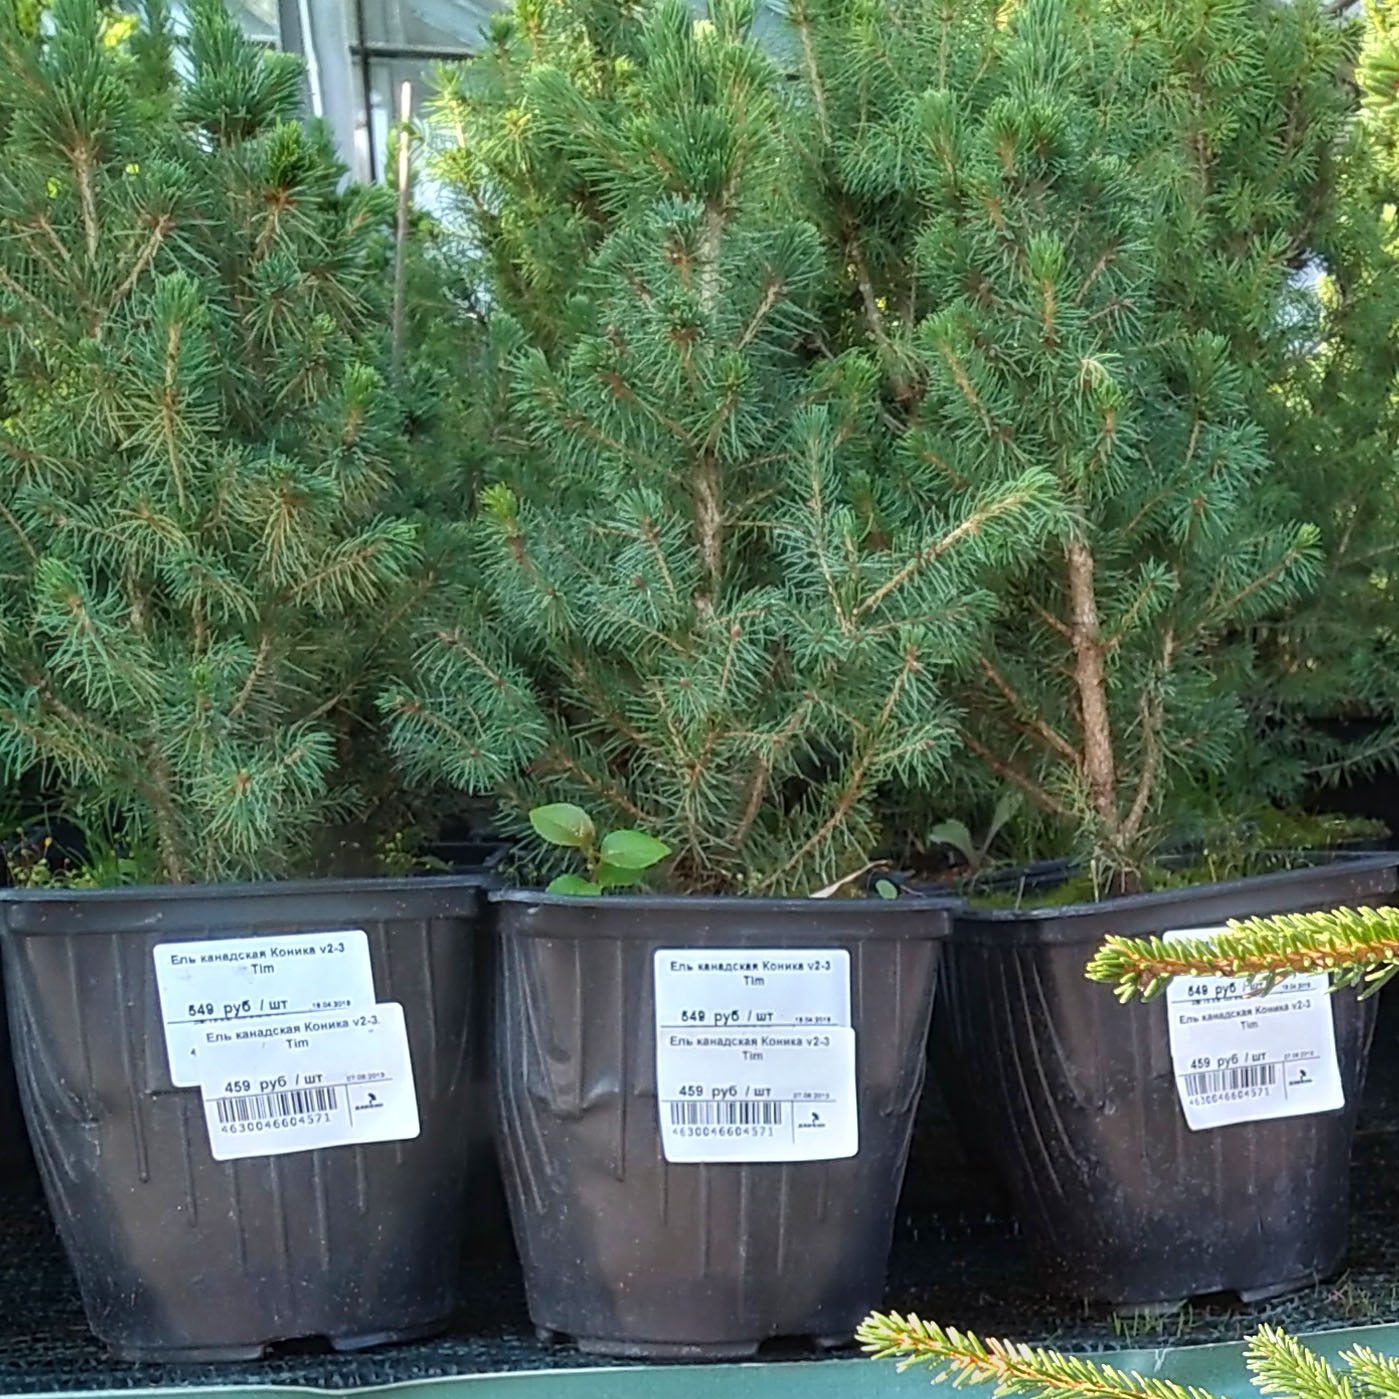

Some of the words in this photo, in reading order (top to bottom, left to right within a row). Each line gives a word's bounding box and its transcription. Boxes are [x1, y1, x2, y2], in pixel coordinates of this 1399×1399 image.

[171, 954, 196, 965] Ель
[201, 951, 267, 963] канадская
[270, 946, 316, 958] Коника
[319, 942, 346, 954] v2-3
[251, 963, 275, 974] Tim
[670, 961, 693, 972] Ель
[697, 961, 759, 972] канадская
[762, 960, 804, 971] Коника
[807, 960, 831, 971] v2-3
[743, 975, 765, 986] Tim
[1215, 982, 1236, 998] руб
[223, 1000, 251, 1018] руб
[269, 1000, 288, 1011] шт
[1179, 1015, 1199, 1024] Ель
[1202, 1009, 1252, 1020] канадская
[1255, 1004, 1289, 1015] Коника
[714, 1010, 740, 1026] руб
[756, 1011, 774, 1022] шт
[1240, 1020, 1258, 1030] Tim
[206, 1032, 232, 1043] Ель
[236, 1025, 301, 1039] канадская
[304, 1020, 349, 1032] Коника
[352, 1015, 378, 1027] v2-3
[286, 1039, 309, 1049] Tim
[669, 1036, 693, 1046] Ель
[696, 1036, 758, 1047] канадская
[761, 1036, 803, 1046] Коника
[806, 1036, 830, 1047] v2-3
[742, 1050, 763, 1061] Tim
[1190, 1058, 1210, 1069] 459
[1217, 1053, 1238, 1068] руб
[1252, 1052, 1266, 1061] шт
[224, 1080, 251, 1094] 459
[260, 1076, 287, 1092] руб
[304, 1073, 323, 1084] шт
[679, 1085, 703, 1097] 459
[711, 1085, 737, 1100] руб
[754, 1086, 771, 1097] шт
[221, 1112, 332, 1134] 4630046604571
[672, 1127, 774, 1137] 4630046604571
